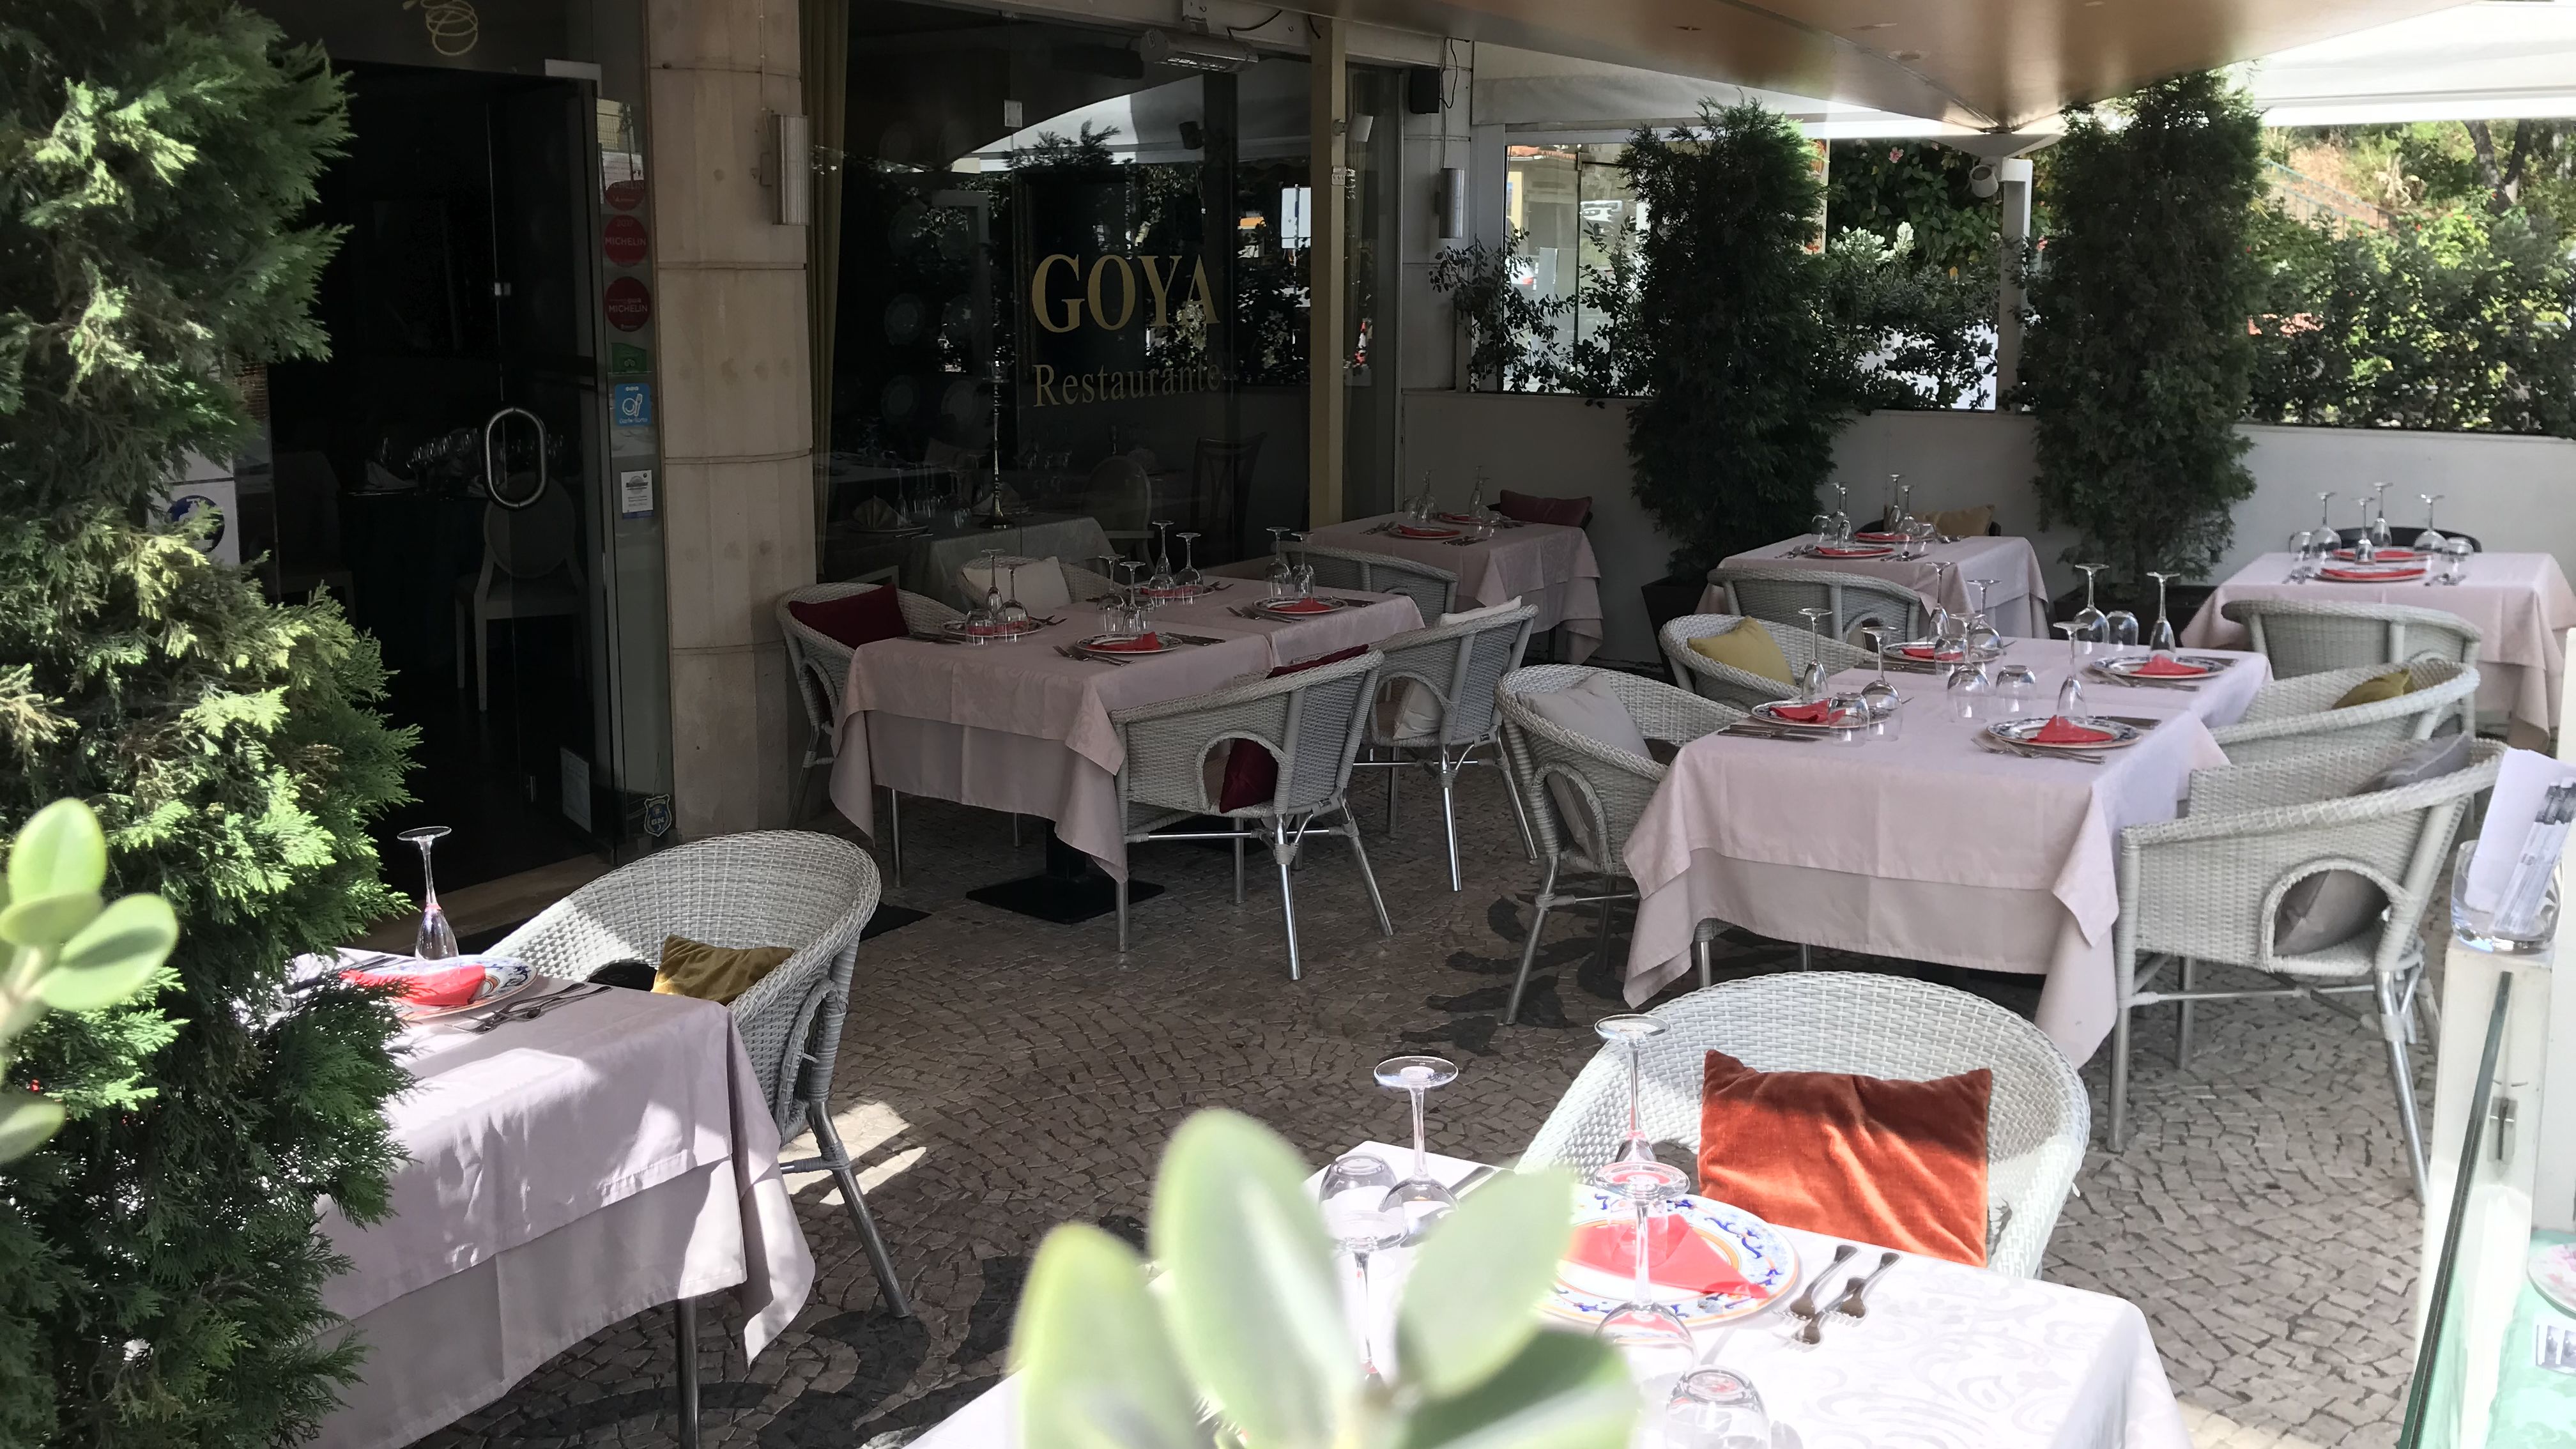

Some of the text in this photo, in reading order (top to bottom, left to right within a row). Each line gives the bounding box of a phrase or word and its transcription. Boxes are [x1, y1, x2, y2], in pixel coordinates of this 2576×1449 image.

[605, 237, 647, 245] MICHELIN
[1032, 254, 1220, 333] GOYA
[1033, 360, 1221, 407] Restaurante
